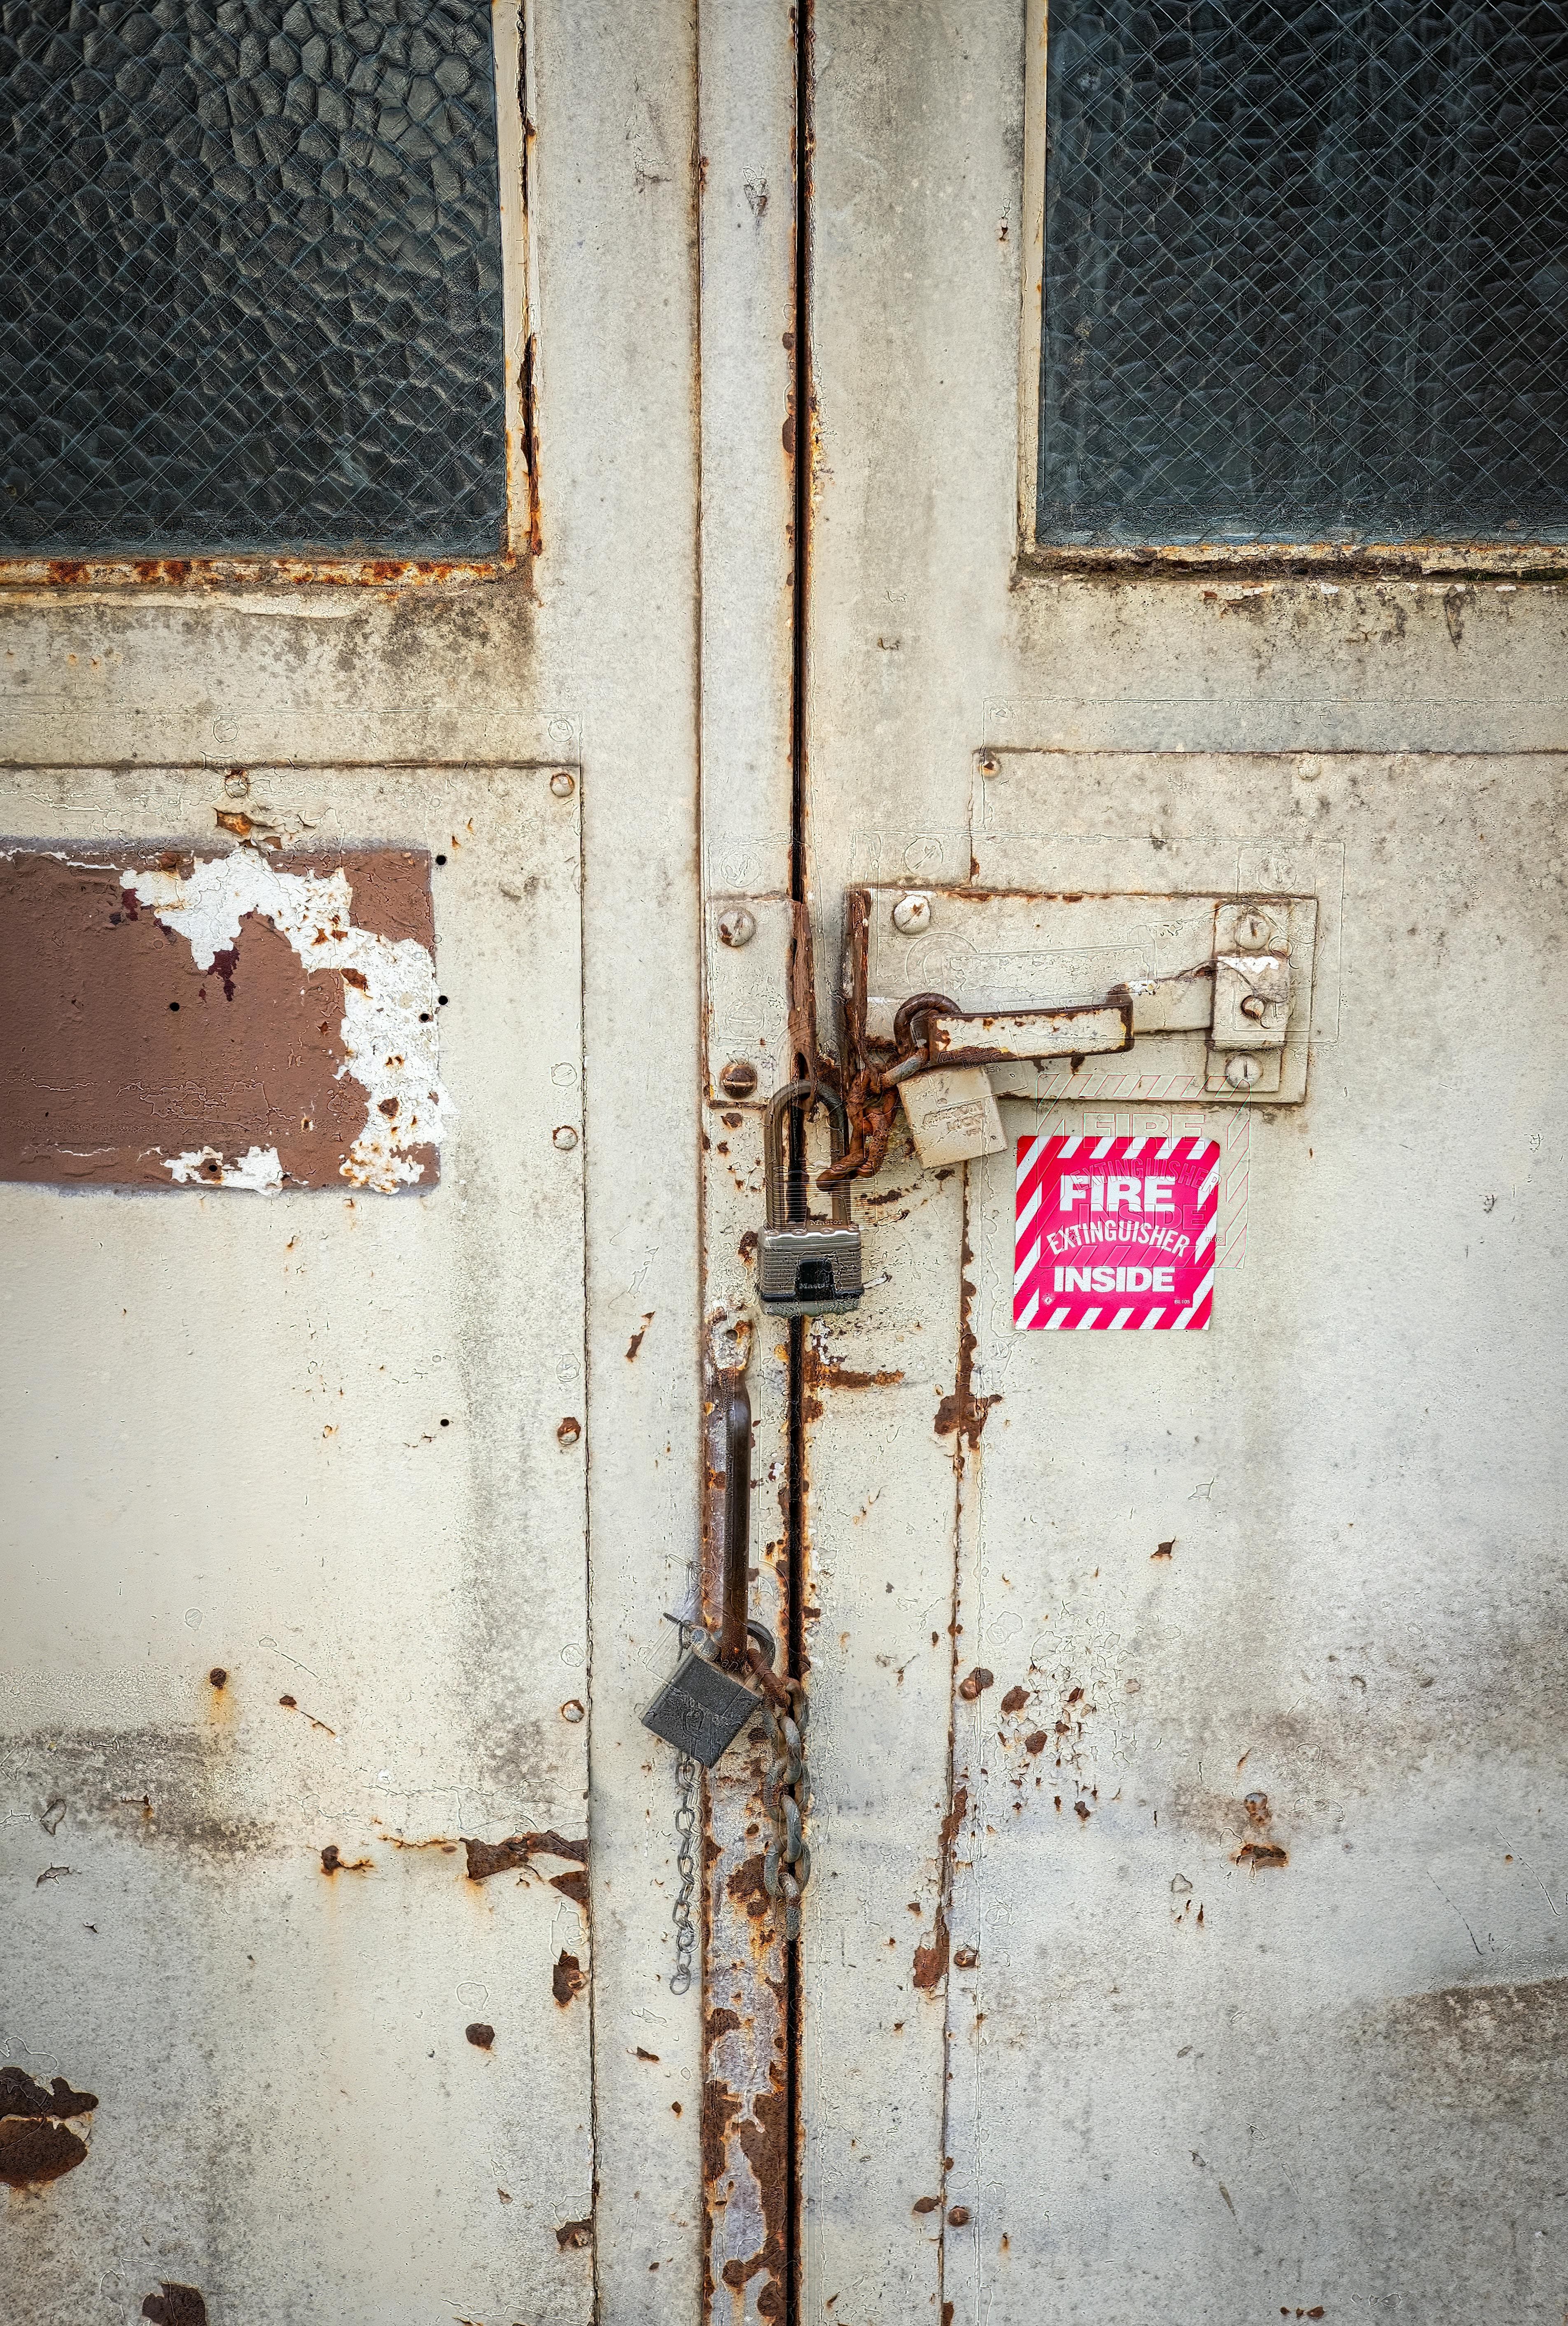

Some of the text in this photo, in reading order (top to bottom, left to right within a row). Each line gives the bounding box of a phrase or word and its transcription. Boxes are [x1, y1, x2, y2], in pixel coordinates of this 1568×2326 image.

[1059, 1175, 1176, 1212] FIRE
[1046, 1219, 1190, 1257] EXTINGUISHER
[1054, 1266, 1175, 1293] INSIDE
